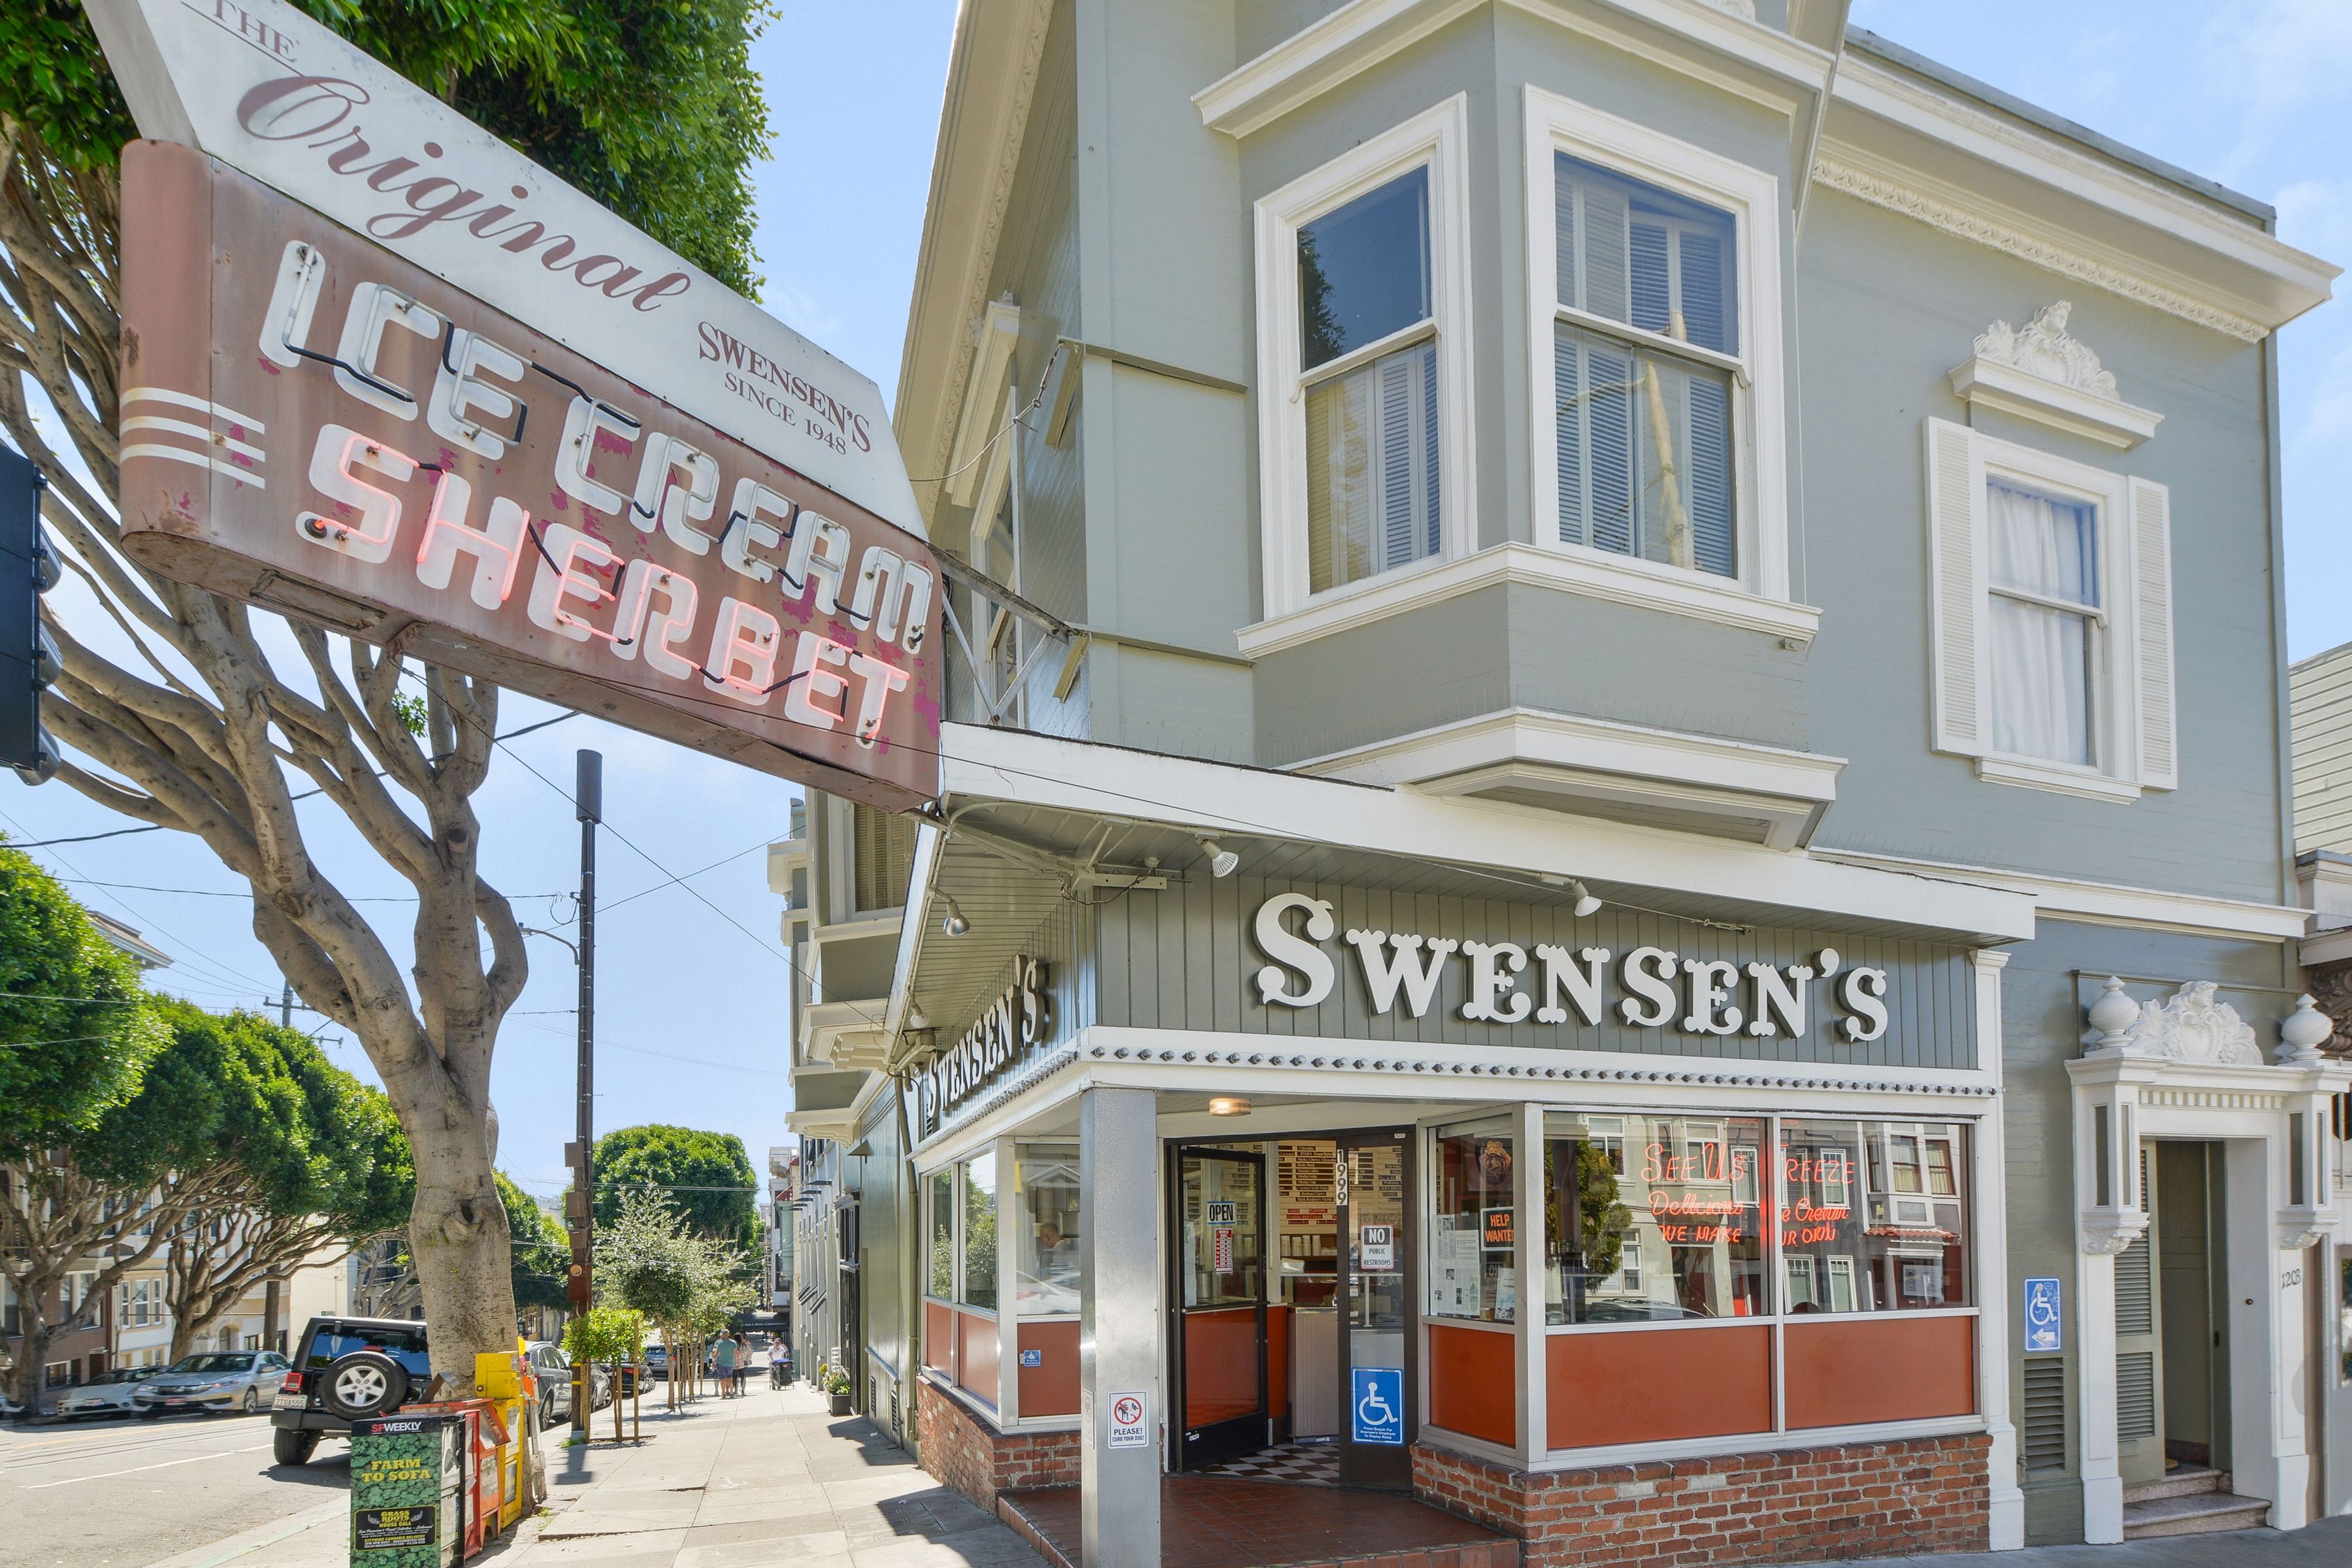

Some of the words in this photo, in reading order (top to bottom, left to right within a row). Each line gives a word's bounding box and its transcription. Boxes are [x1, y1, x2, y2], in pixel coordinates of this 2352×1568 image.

[212, 0, 298, 63] THE
[236, 75, 693, 312] Original
[698, 321, 871, 453] SWENSEN'S
[725, 372, 796, 427] SINCE
[804, 418, 847, 455] 1948
[259, 239, 525, 461] ICE
[553, 395, 934, 653] CREAM
[295, 423, 911, 750] SHERBET
[1252, 892, 1888, 1043] SWENSEN'S
[928, 954, 1040, 1118] SWENSEN'S
[1337, 1150, 1347, 1205] 1999
[1780, 1143, 1857, 1184] REEZE
[1209, 1204, 1234, 1222] OPEN
[1369, 1228, 1385, 1243] NO
[1490, 1214, 1510, 1227] HELP
[1658, 1225, 1688, 1242] WE
[1695, 1225, 1742, 1243] MAKE
[2281, 1268, 2301, 1290] 1203
[362, 1472, 385, 1482] TO
[389, 1469, 431, 1481] SOFA
[371, 1458, 421, 1471] FARM
